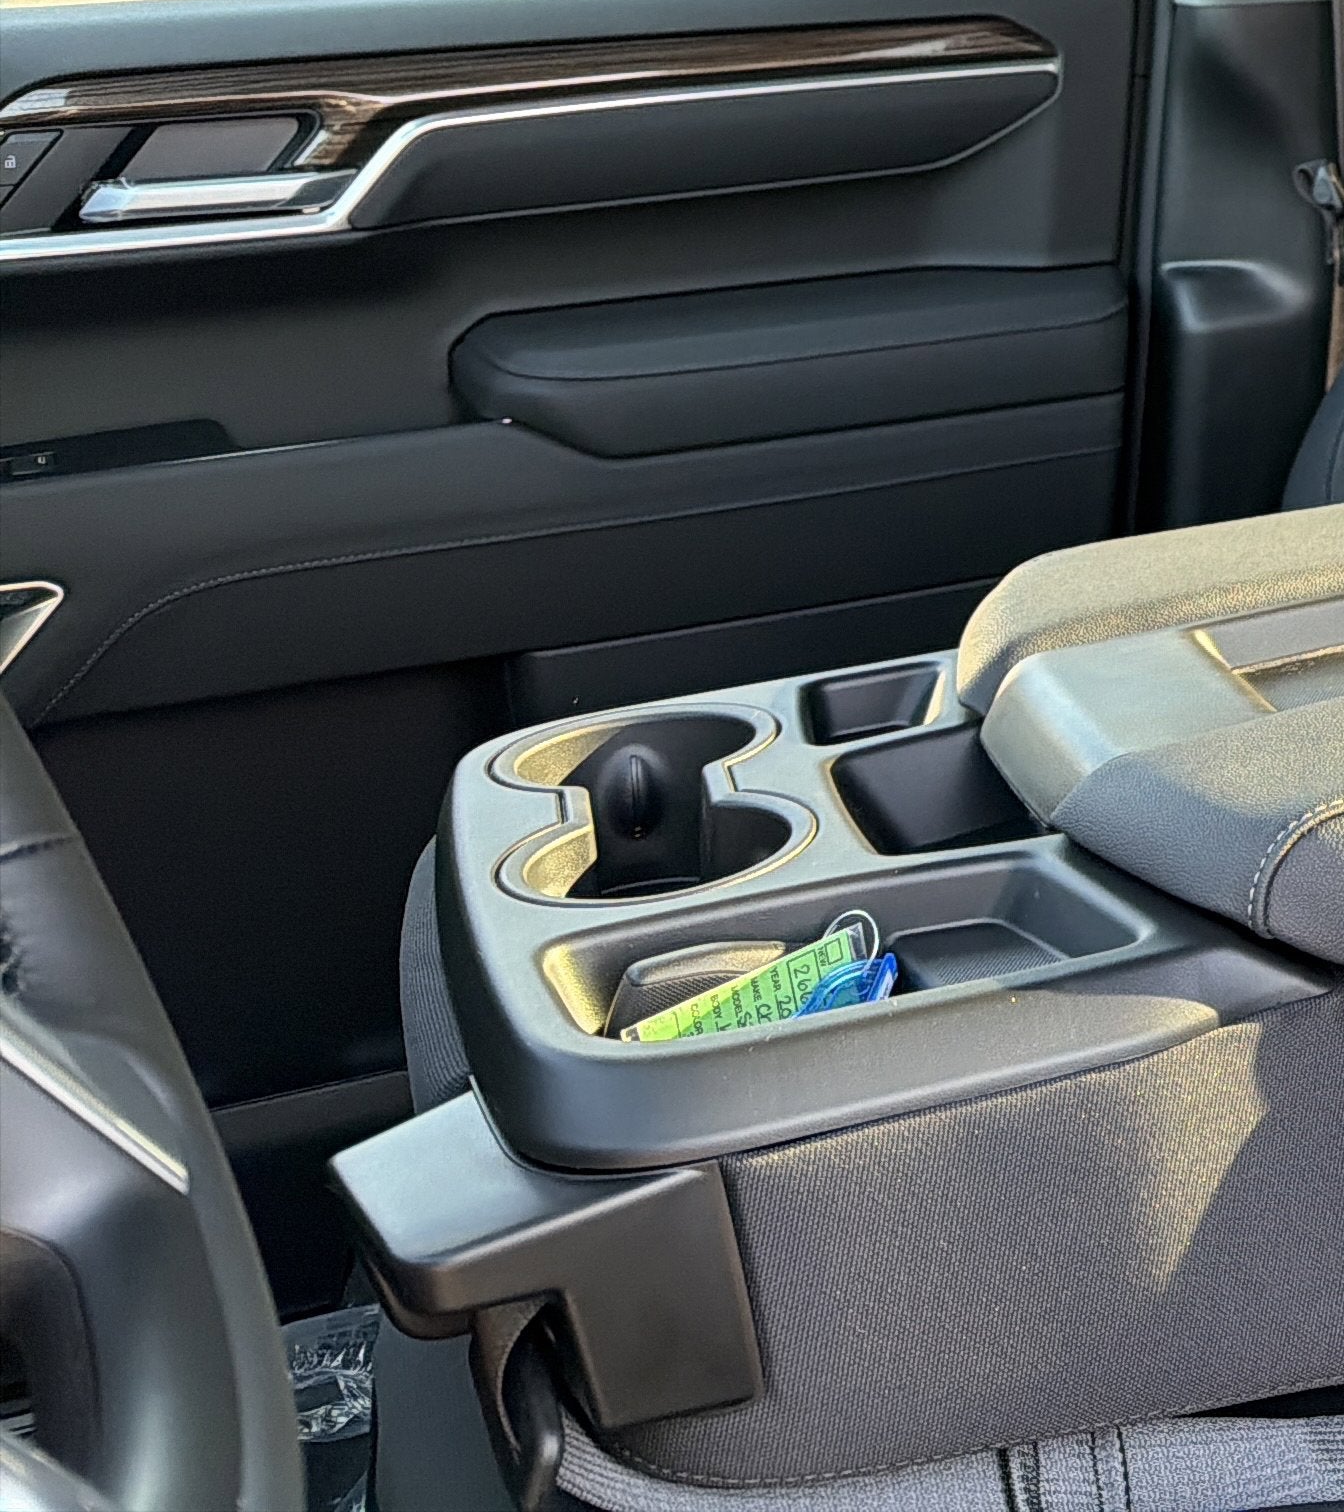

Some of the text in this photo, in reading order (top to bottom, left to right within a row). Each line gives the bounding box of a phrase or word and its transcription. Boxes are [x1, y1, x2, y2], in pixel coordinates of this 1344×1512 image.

[750, 977, 762, 1002] MAKE
[769, 965, 781, 992] YEAR
[710, 994, 722, 1018] BODY
[731, 984, 742, 1018] MODEL
[690, 1003, 704, 1036] COLOR
